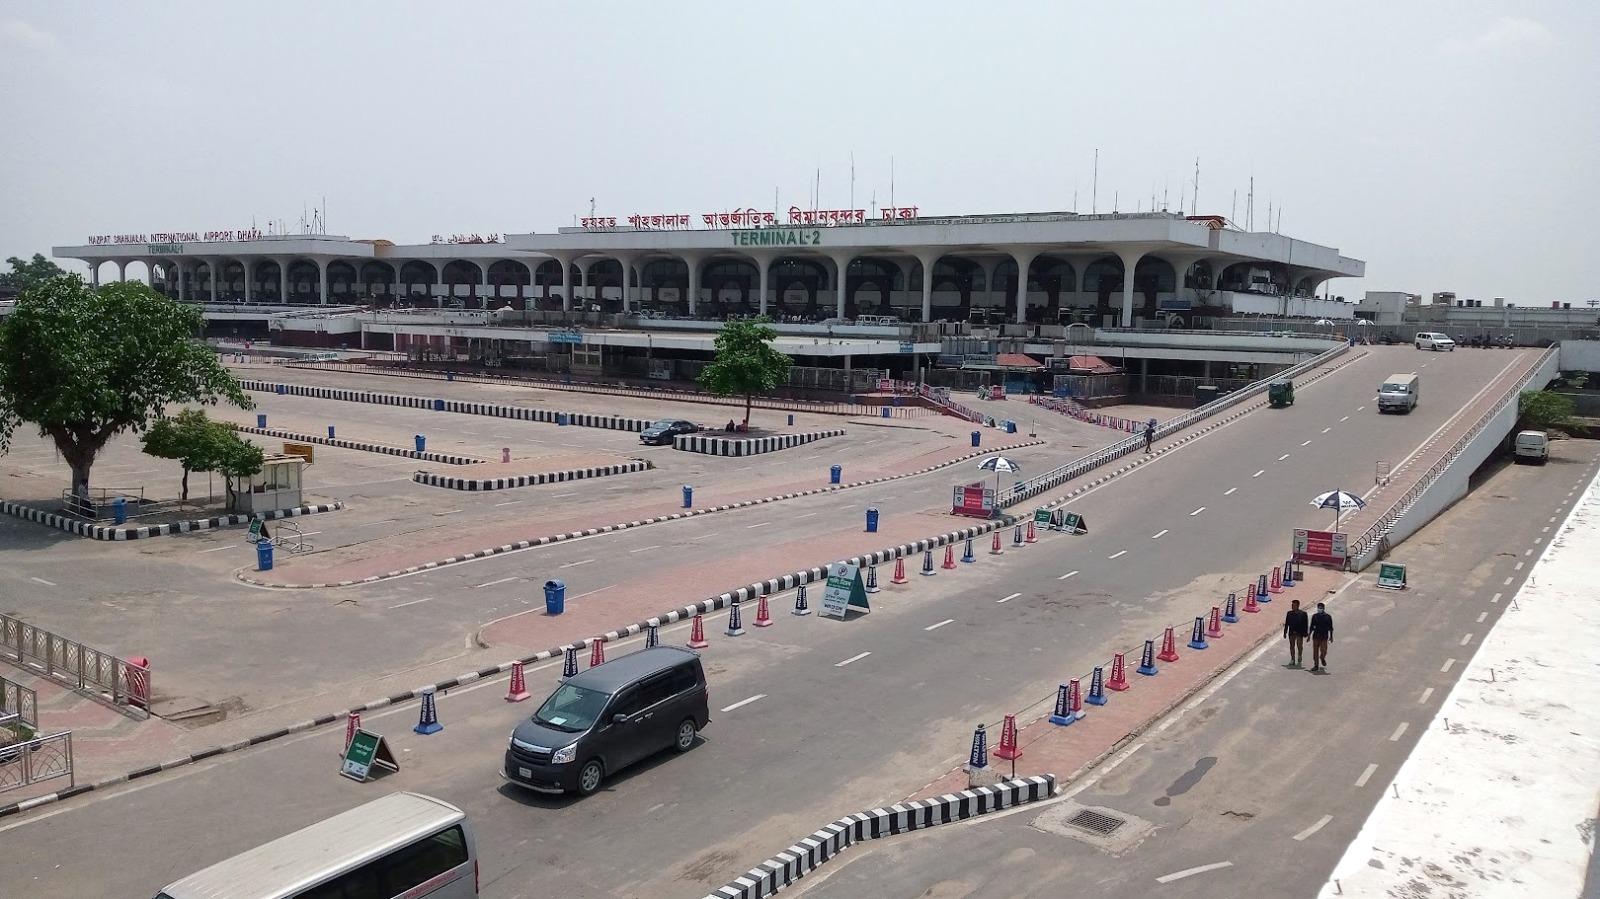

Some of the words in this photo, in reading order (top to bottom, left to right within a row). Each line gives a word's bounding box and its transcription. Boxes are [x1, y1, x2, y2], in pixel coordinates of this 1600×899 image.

[580, 216, 618, 229] হযরত
[627, 213, 691, 230] শাহজালাল
[702, 208, 775, 227] আন্তর্জাতিক
[788, 206, 866, 224] বিমানবন্দর
[880, 206, 918, 221] ঢাকা
[150, 232, 198, 243] INTERNATIONAL
[203, 231, 233, 241] AIRPORT
[237, 229, 263, 240] DHAKA
[731, 230, 821, 246] TERMINAL-2
[1057, 688, 1065, 715] WALTON
